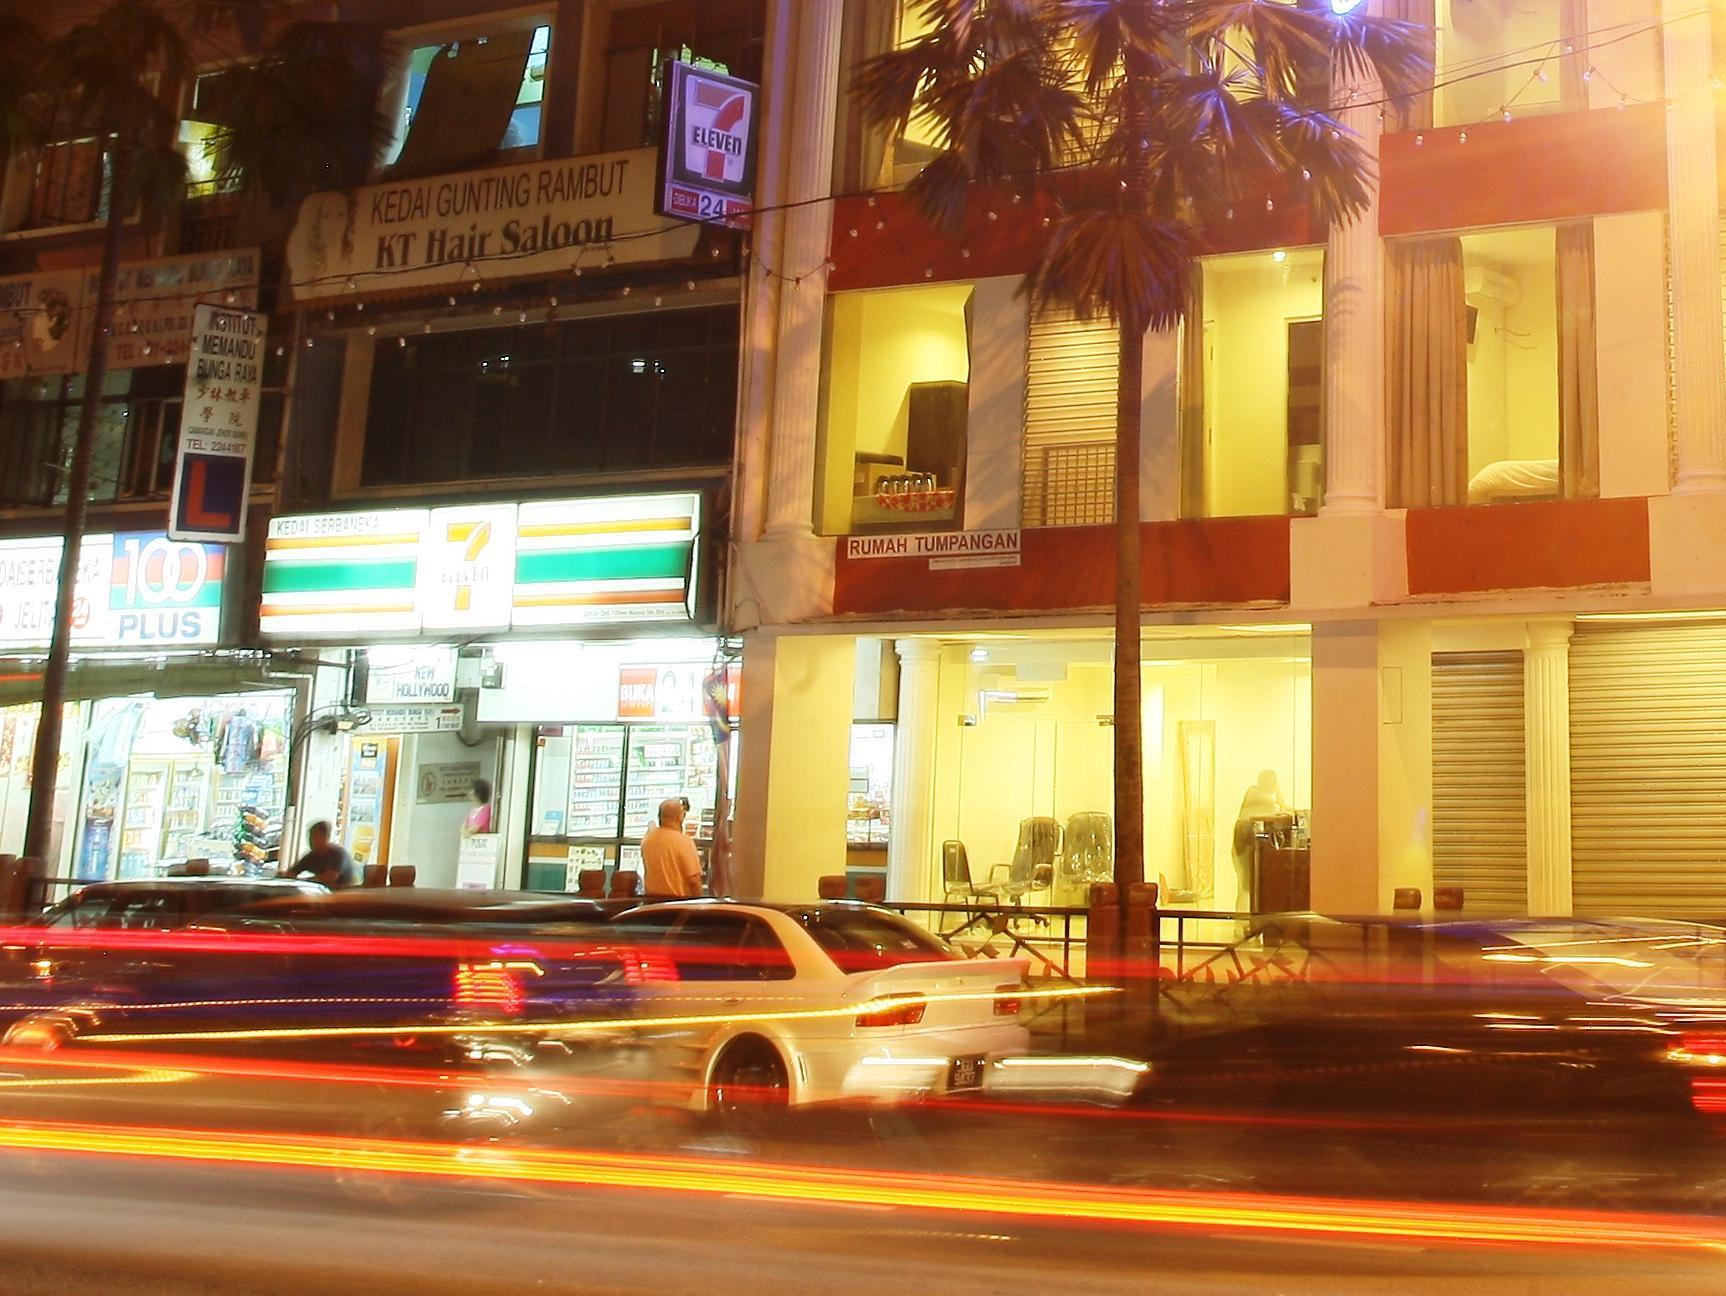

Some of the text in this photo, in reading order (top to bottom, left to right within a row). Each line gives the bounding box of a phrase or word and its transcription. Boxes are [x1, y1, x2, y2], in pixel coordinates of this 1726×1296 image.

[370, 159, 629, 226] KEDAI GUNTING RAMBUT
[700, 194, 724, 217] 24
[374, 214, 615, 269] KT Hair Saloon
[201, 334, 257, 360] MEMANDU
[196, 358, 257, 384] BUNGA RAYA
[276, 519, 309, 536] KEDAI
[849, 532, 1018, 556] RUMAH TUMPANGAN
[123, 537, 208, 605] 100
[118, 611, 202, 640] PLUS
[396, 682, 450, 697] HOLLYWOOD
